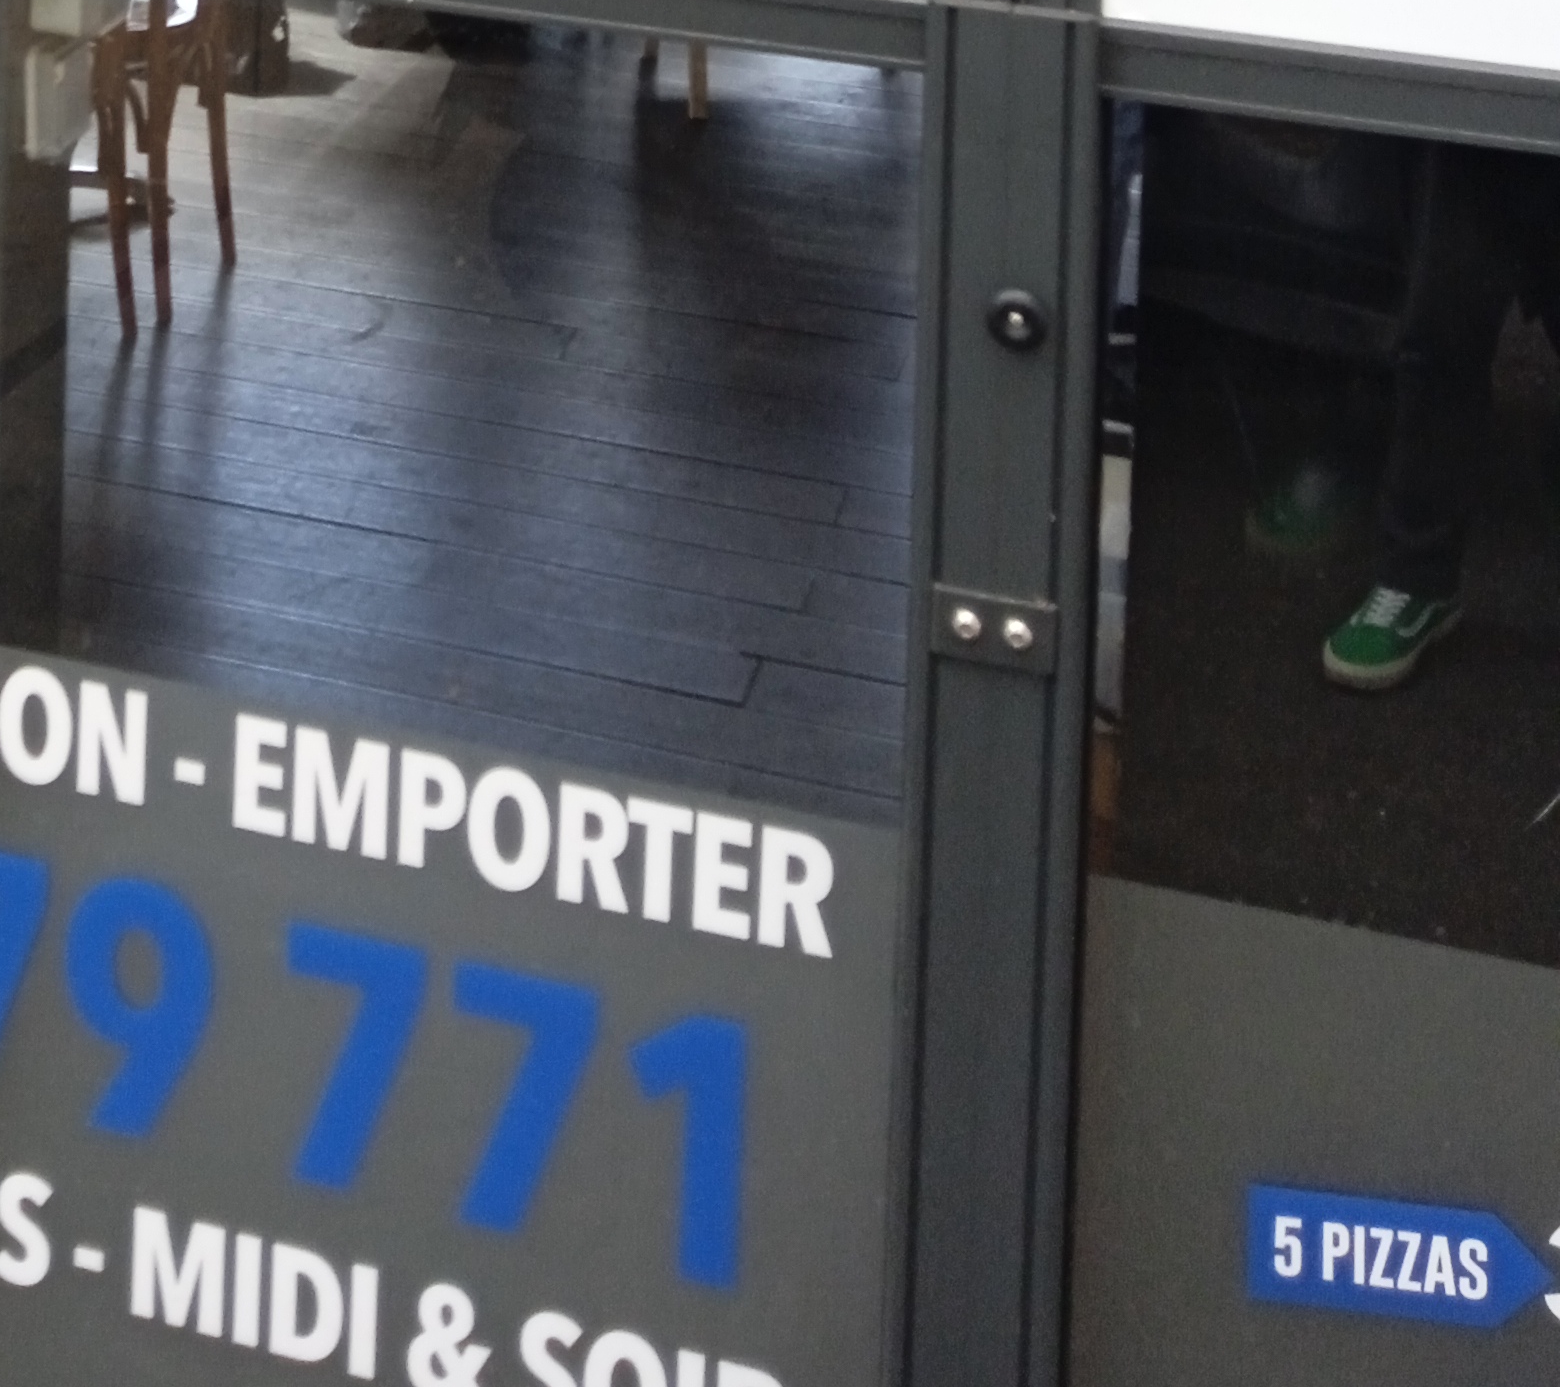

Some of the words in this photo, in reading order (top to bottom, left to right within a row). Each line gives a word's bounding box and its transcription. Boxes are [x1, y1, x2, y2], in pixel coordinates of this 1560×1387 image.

[231, 711, 835, 960] EMPORTER
[286, 921, 748, 1287] 771
[130, 1204, 381, 1381] MIDI
[405, 1282, 493, 1387] &
[1274, 1214, 1304, 1278] 5
[1322, 1220, 1489, 1301] PIZZAS
